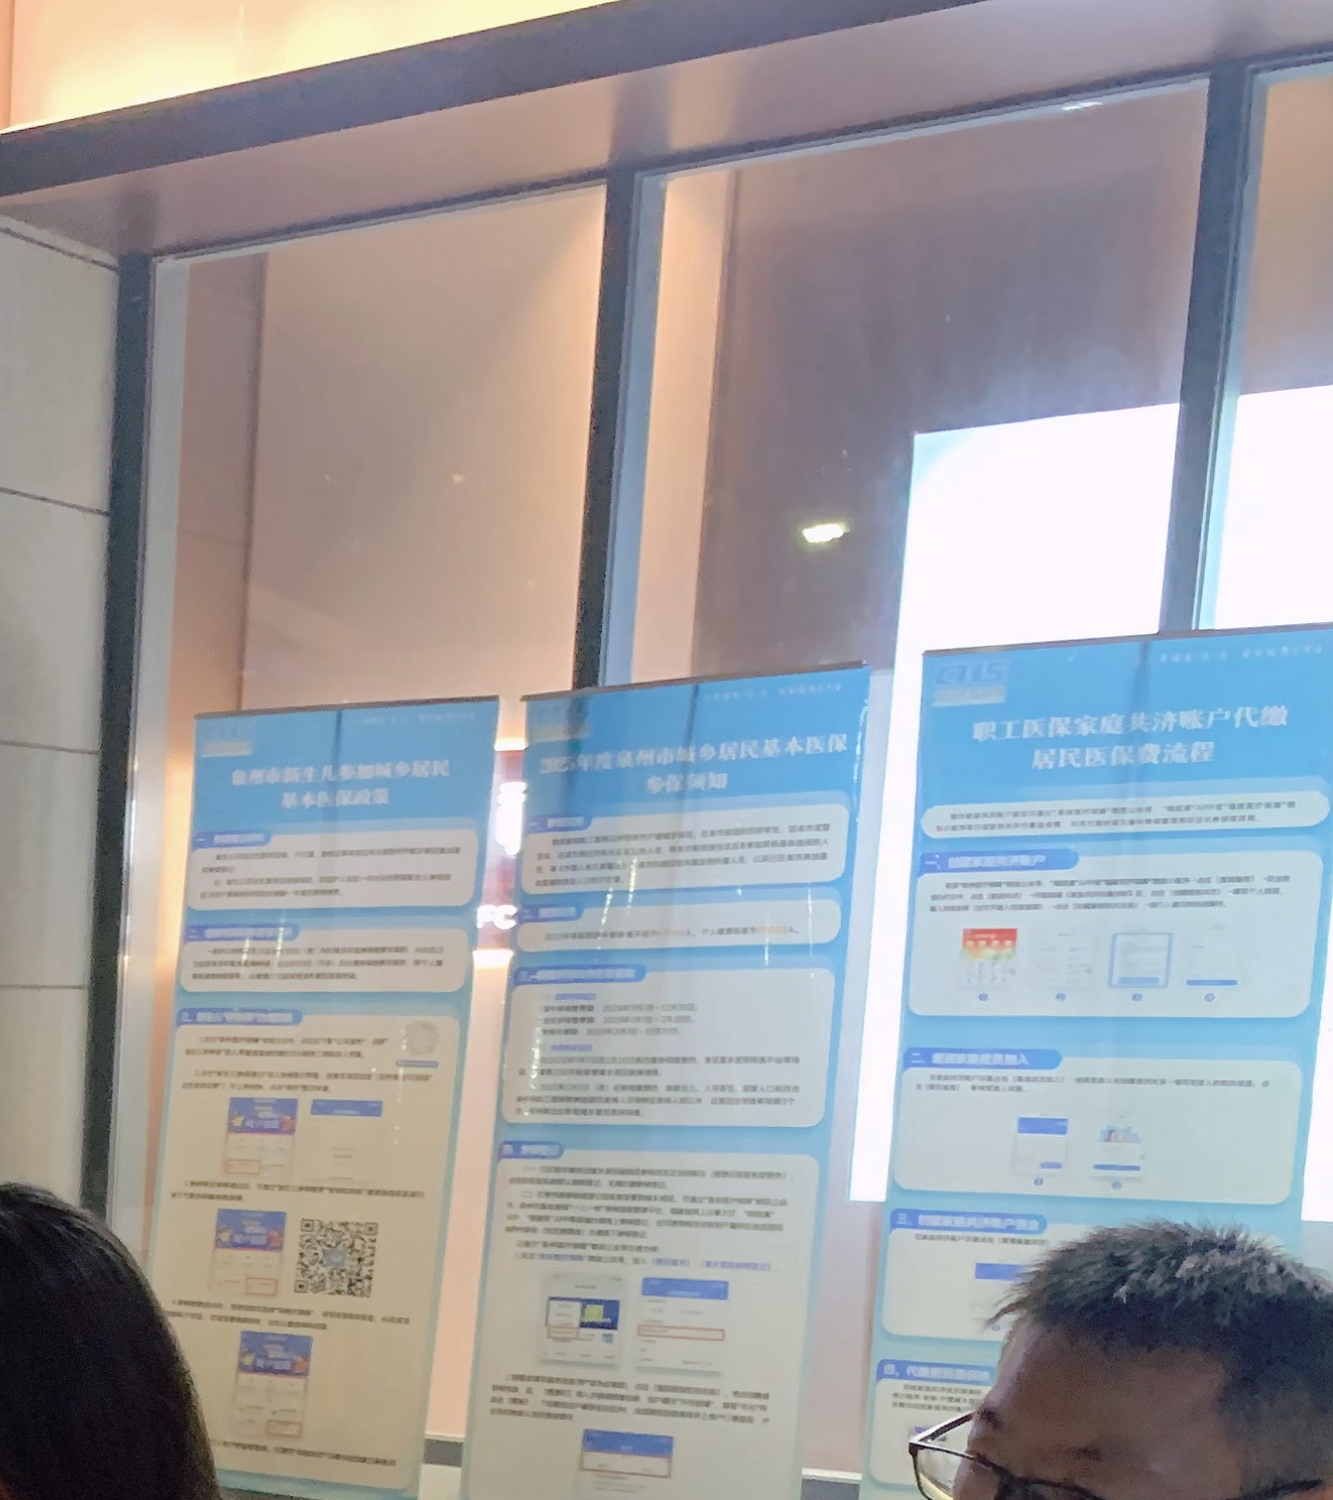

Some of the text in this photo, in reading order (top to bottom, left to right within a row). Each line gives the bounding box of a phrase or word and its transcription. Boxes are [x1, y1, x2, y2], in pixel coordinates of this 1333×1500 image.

[1032, 740, 1215, 770] 居民医保费流程
